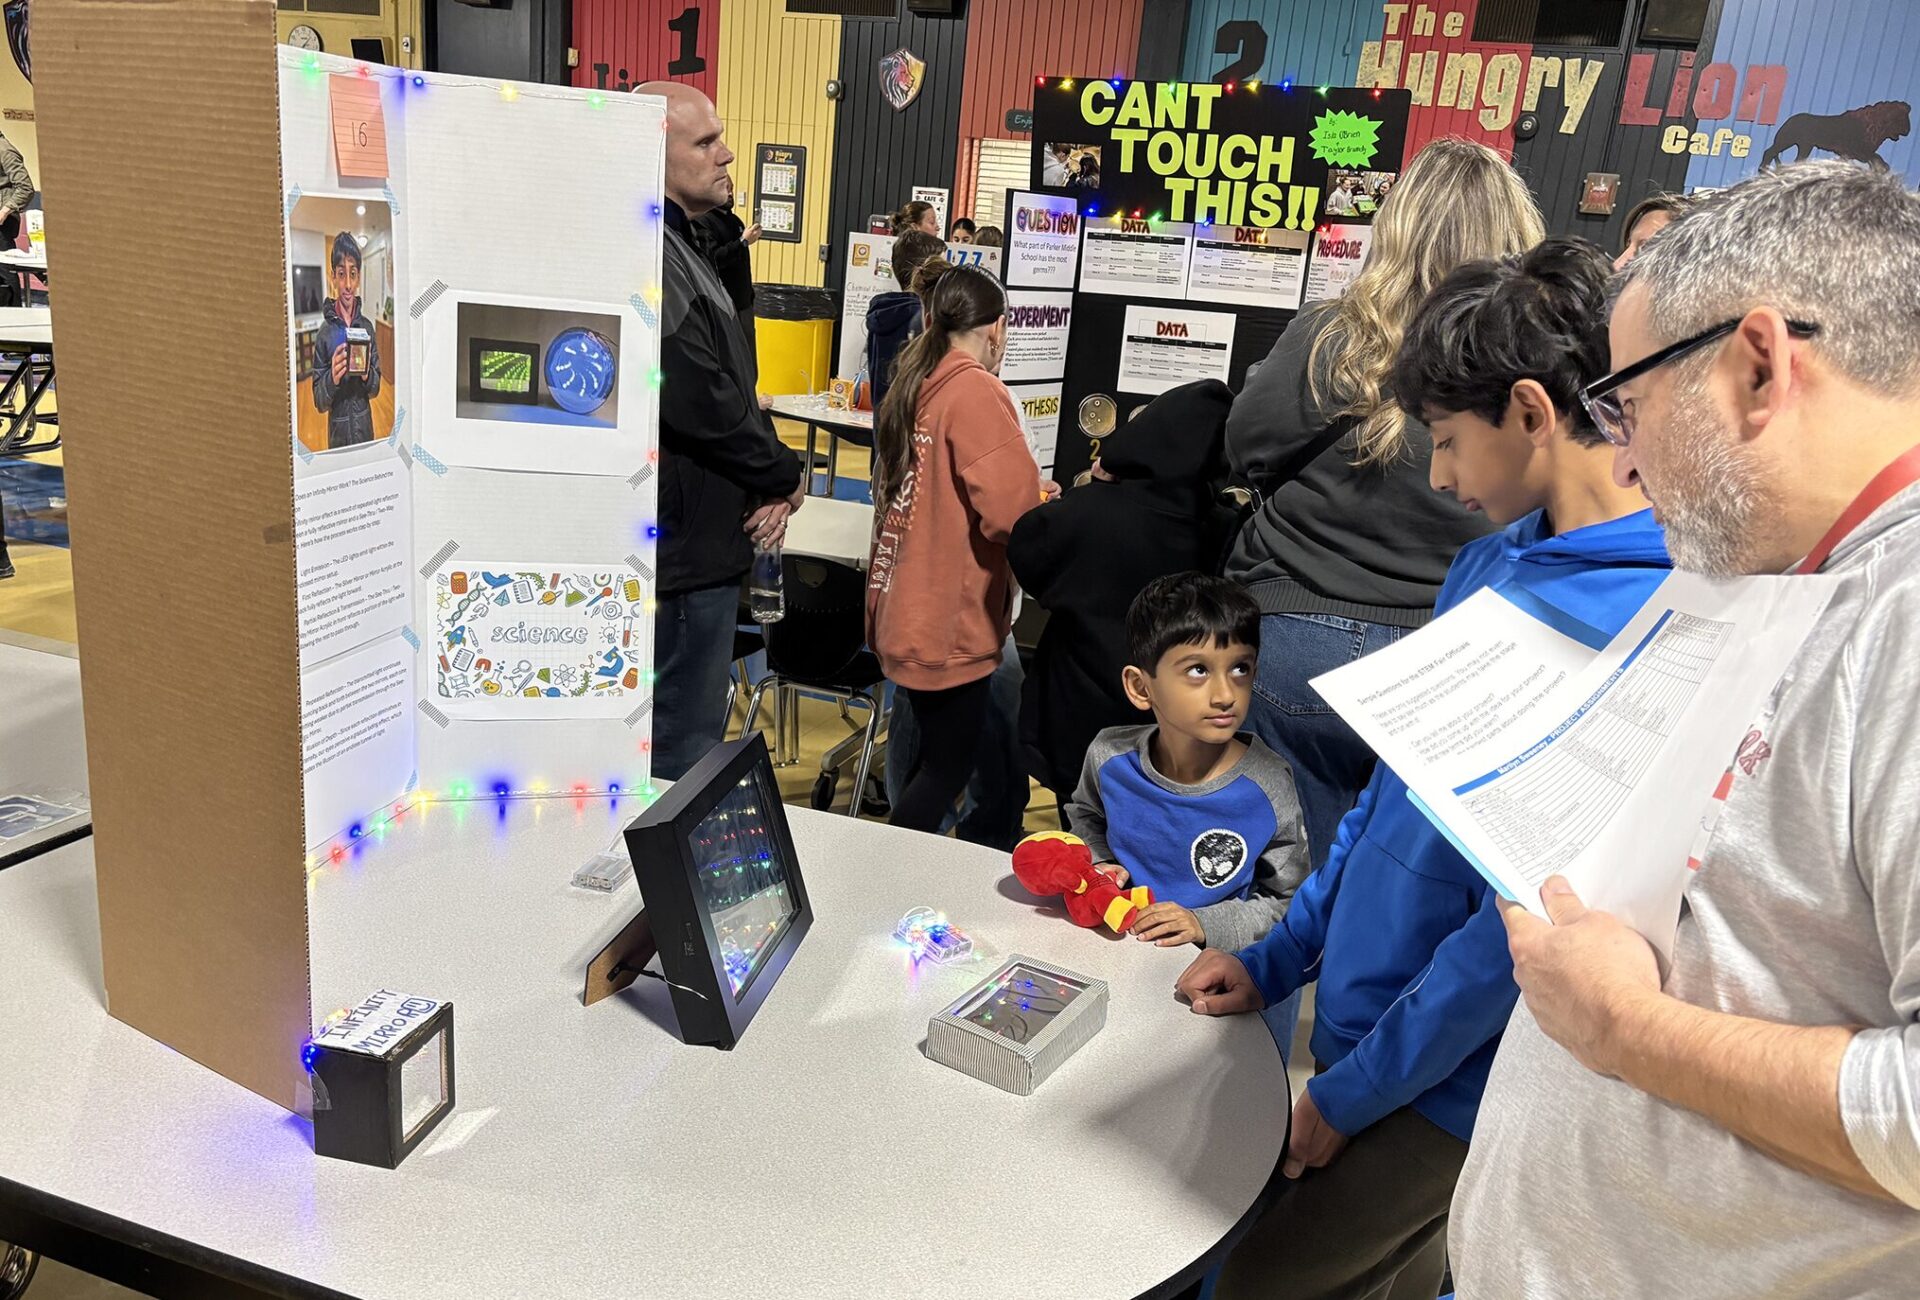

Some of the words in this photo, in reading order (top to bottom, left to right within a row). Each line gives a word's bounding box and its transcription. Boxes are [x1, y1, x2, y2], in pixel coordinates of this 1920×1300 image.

[1382, 3, 1465, 38] The
[668, 7, 706, 76] 1
[1356, 40, 1604, 135] Hungry
[1620, 52, 1787, 126] Lion
[1080, 80, 1222, 130] CANT
[351, 121, 368, 148] 16
[1661, 125, 1752, 158] Cafe
[1110, 128, 1295, 183] TOUCH
[1164, 178, 1320, 231] THIS!!
[1016, 206, 1079, 236] QUESTION
[1121, 219, 1151, 234] DATA
[1014, 240, 1028, 249] What
[1028, 242, 1040, 250] part
[1040, 242, 1046, 250] of
[1046, 243, 1061, 251] Parker
[1062, 244, 1077, 253] Middle
[1021, 253, 1038, 262] School
[1039, 254, 1047, 262] has
[1048, 254, 1056, 262] the
[1317, 239, 1363, 260] PROCEDURE
[1008, 305, 1071, 328] EXPERIMENT
[1156, 320, 1189, 338] DATA
[1089, 438, 1101, 461] 2
[490, 620, 589, 645] science
[1418, 663, 1435, 676] STEM
[1434, 656, 1447, 667] Fair
[1446, 641, 1470, 659] Officials
[1501, 694, 1511, 704] for
[1511, 684, 1524, 697] your
[1523, 664, 1547, 686] project?
[1475, 693, 1495, 711] project?
[1502, 715, 1517, 729] about
[1518, 701, 1535, 717] doing
[1534, 692, 1544, 703] the
[1544, 671, 1567, 694] project?
[1520, 742, 1548, 762] Sweeney
[1550, 711, 1580, 739] PROJECT
[1580, 668, 1624, 713] ASSIGNMENTS
